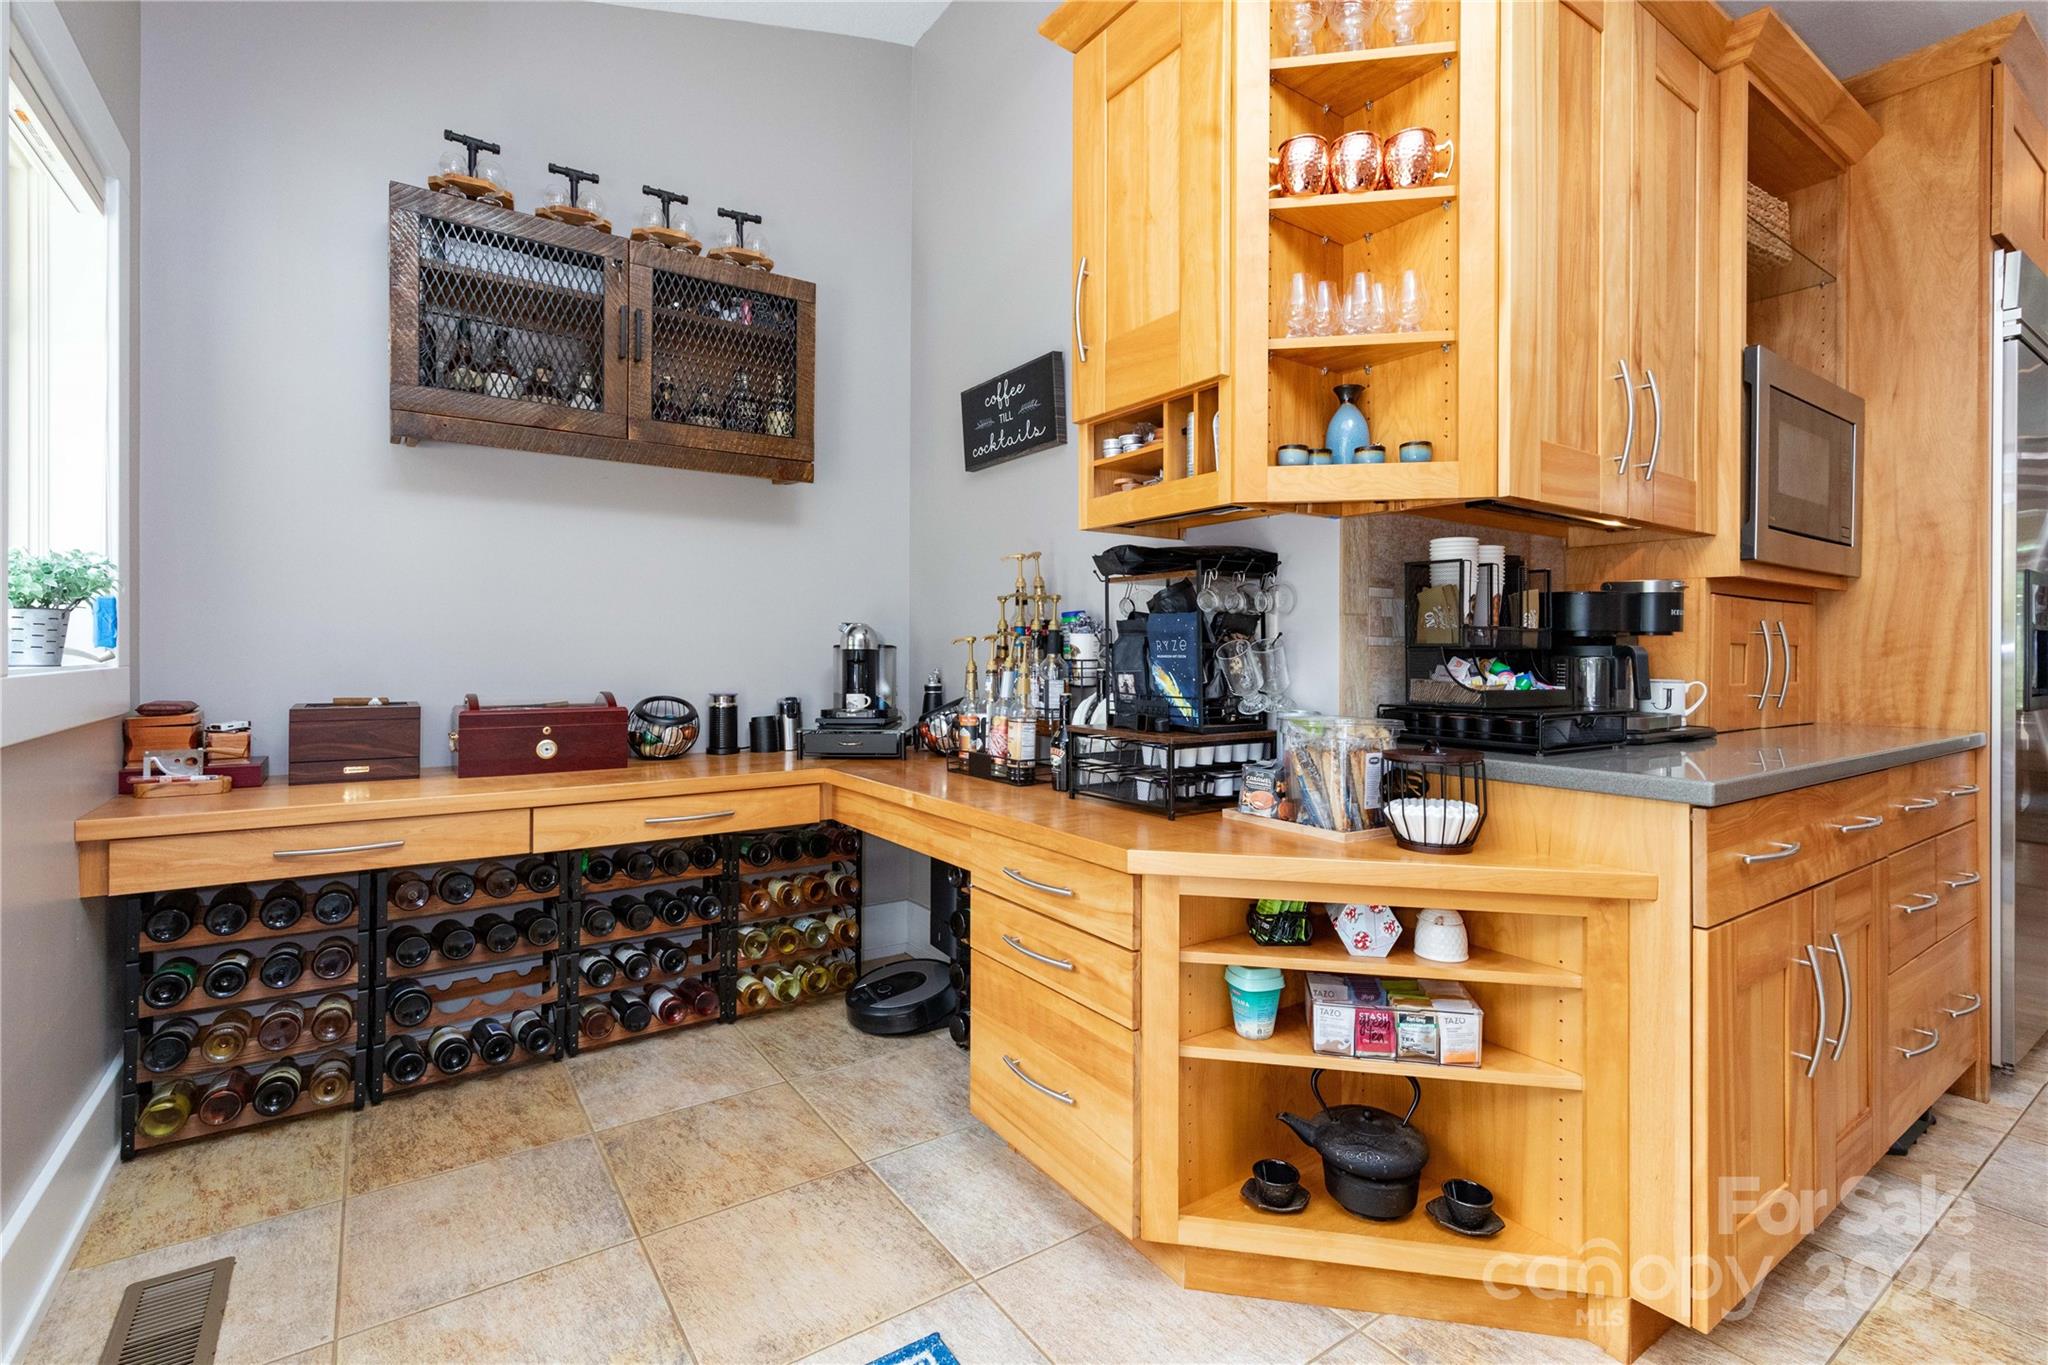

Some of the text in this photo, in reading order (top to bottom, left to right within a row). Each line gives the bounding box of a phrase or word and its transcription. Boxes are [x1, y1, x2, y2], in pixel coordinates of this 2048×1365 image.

[984, 379, 1026, 410] coffee
[998, 411, 1014, 424] TILL
[972, 419, 1047, 458] cocktails
[1651, 687, 1674, 711] J
[1313, 989, 1336, 999] TAZO
[1320, 1007, 1342, 1018] TAZO
[1358, 1012, 1389, 1023] STASH
[1444, 1017, 1467, 1026] TAZO
